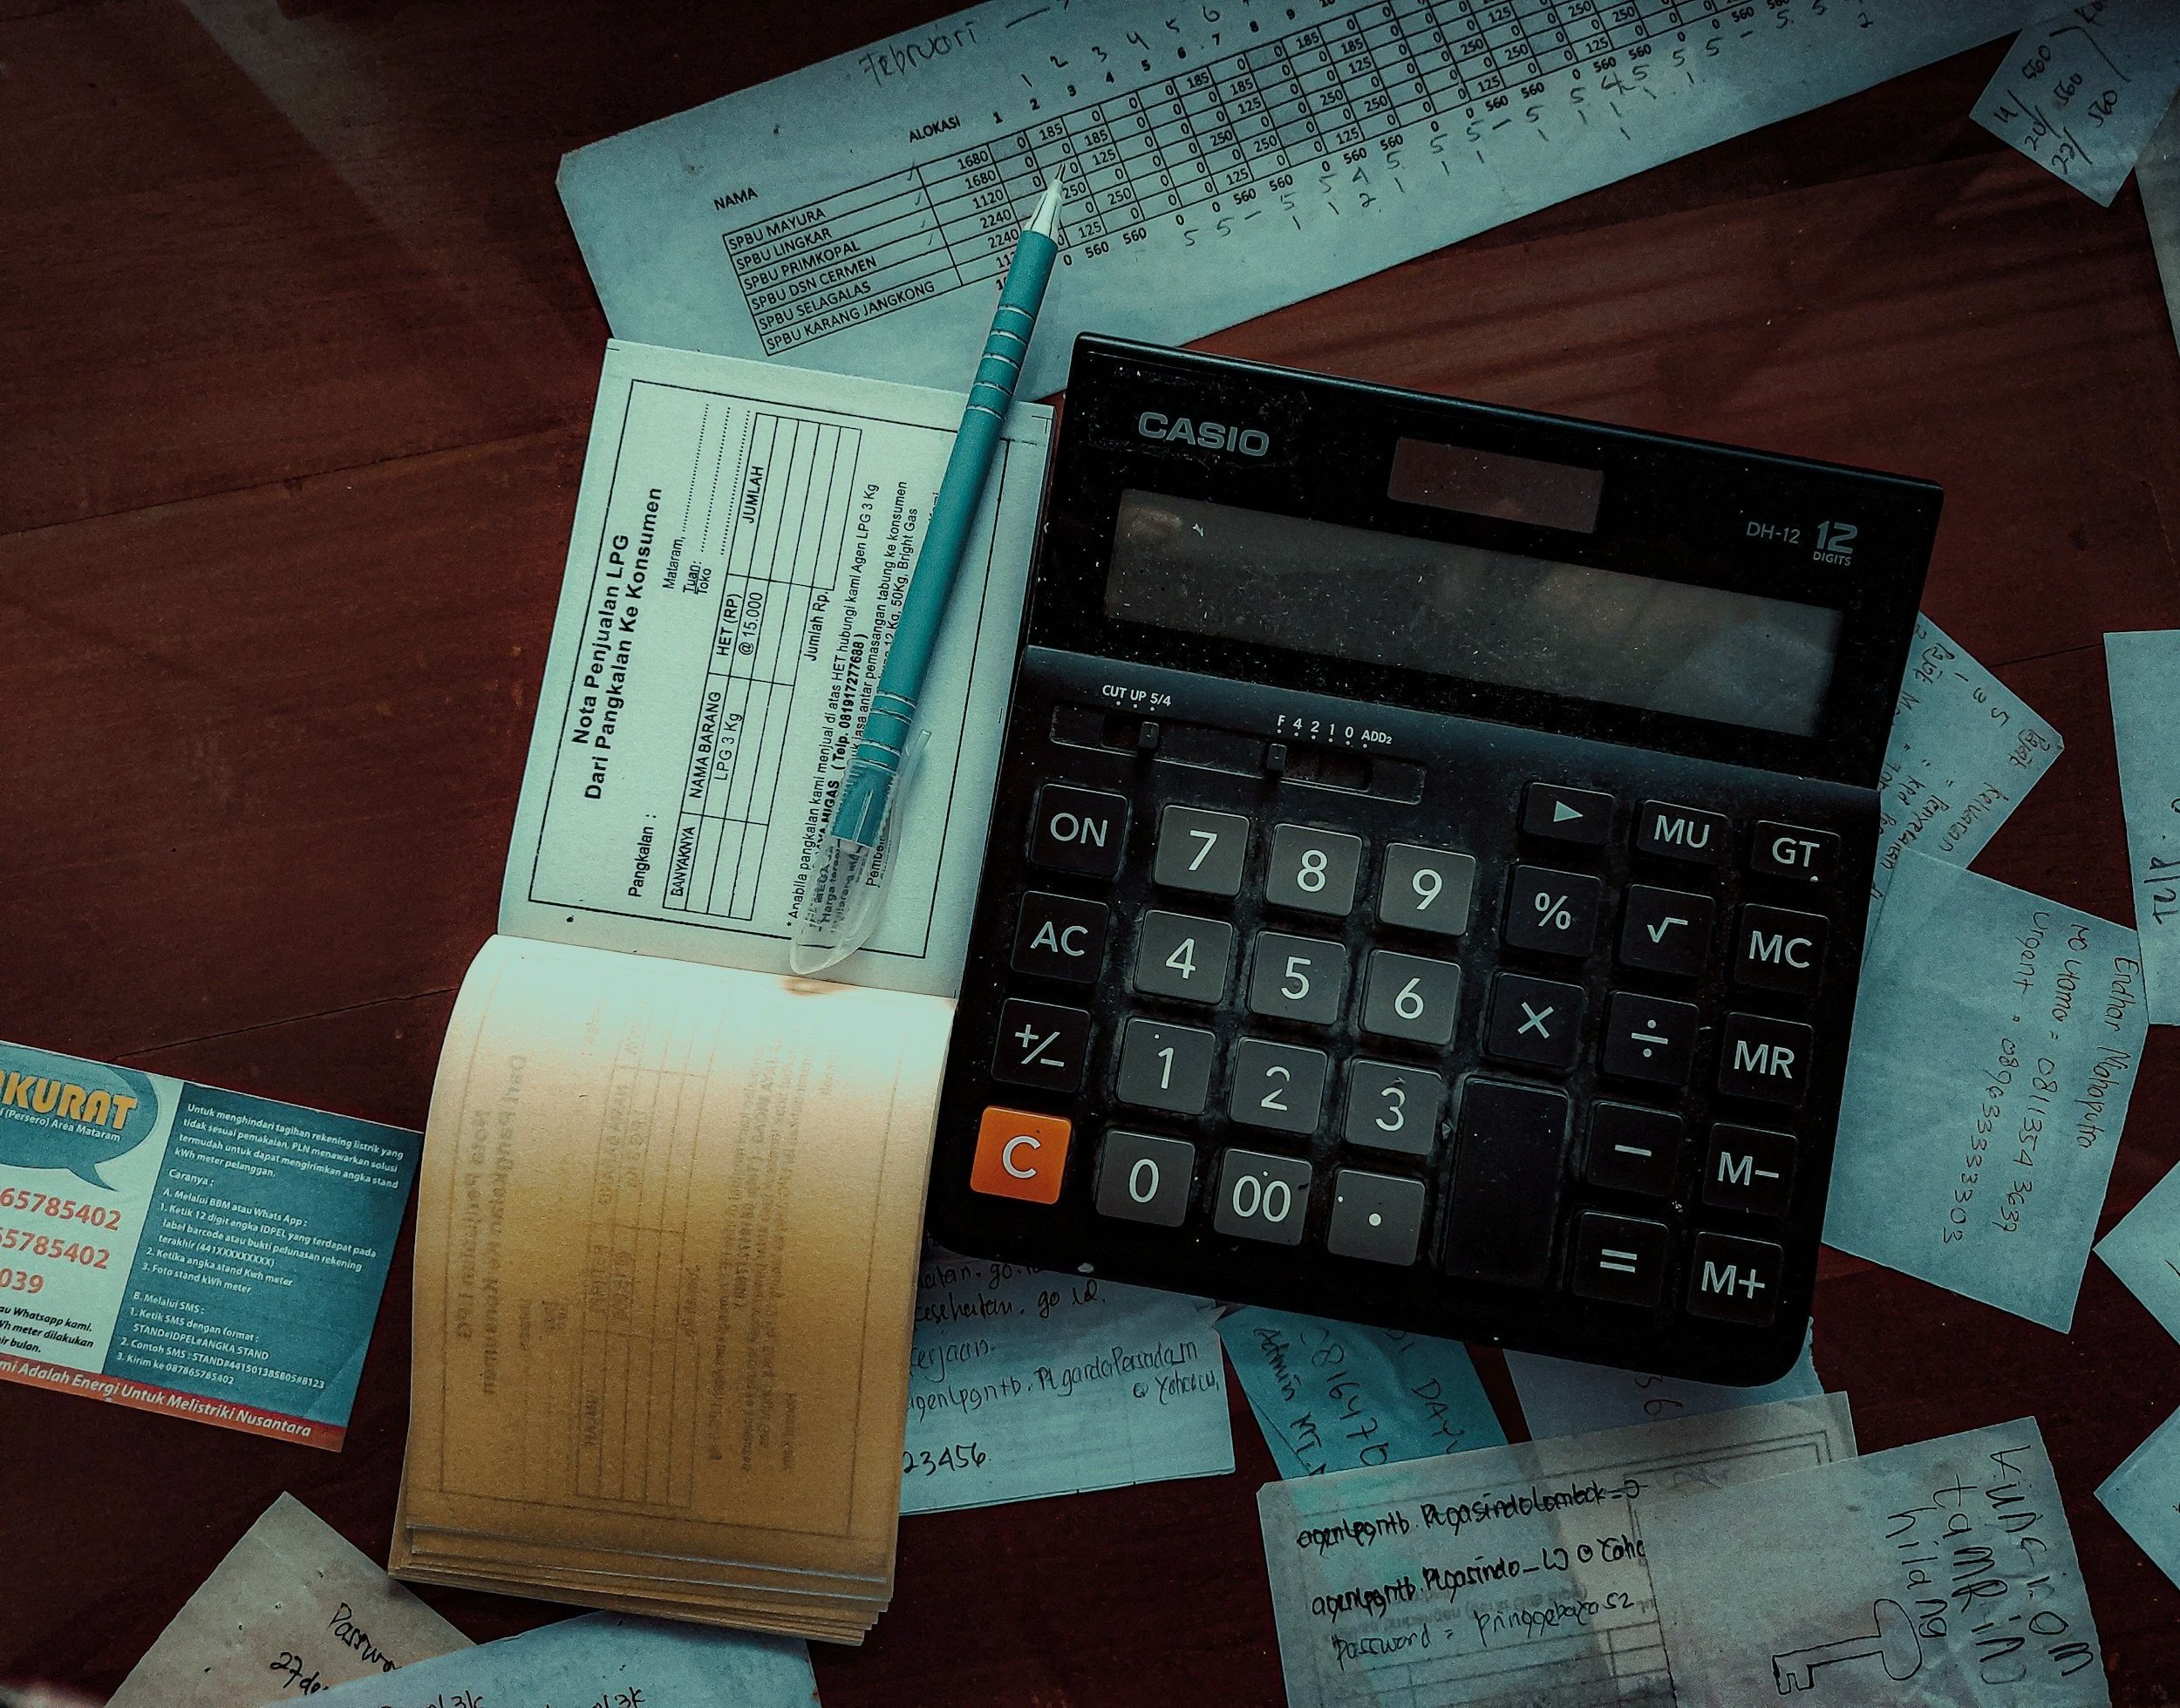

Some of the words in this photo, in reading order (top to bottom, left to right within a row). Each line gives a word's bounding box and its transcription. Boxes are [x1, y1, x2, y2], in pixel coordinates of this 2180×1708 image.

[713, 187, 759, 211] NAMA
[909, 115, 961, 143] ALOKASI
[957, 150, 989, 170] 1680
[1039, 123, 1063, 140] 185
[964, 170, 996, 189] 1680
[972, 189, 1004, 209] 1120
[728, 228, 764, 250] SPBU
[766, 208, 827, 237] MAYURA
[979, 208, 1012, 229] 2240
[987, 228, 1019, 248] 2240
[736, 248, 771, 270] SPBU
[773, 228, 833, 256] LINGKAR
[744, 268, 779, 290] SPBU
[780, 241, 861, 276] PRIMKOPAL
[751, 288, 787, 310] SPBU
[788, 276, 817, 296] DSN
[819, 255, 877, 285] CERMEN
[759, 308, 794, 330] SPBU
[796, 281, 871, 316] SELAGALAS
[766, 328, 801, 350] SPBU
[803, 307, 861, 337] KARANG
[862, 281, 935, 316] JANGKONG
[1138, 412, 1270, 457] CASIO
[742, 466, 764, 523] JUMLAH
[863, 484, 880, 500] Kg
[888, 481, 907, 541] konsumen
[856, 514, 871, 539] LPG
[904, 508, 917, 531] Gas
[1746, 521, 1800, 544] DH-12
[606, 534, 629, 578] LPG
[625, 488, 662, 599] Konsumen
[851, 542, 867, 573] Agen
[883, 544, 896, 558] ke
[896, 534, 914, 569] Bright
[1813, 549, 1853, 566] DIGITS
[1814, 521, 1857, 558] 12
[662, 536, 686, 589] Mataram,
[698, 568, 712, 593] Toko
[876, 561, 896, 600] tabung
[813, 591, 830, 611] Rp.
[844, 574, 861, 602] kami
[890, 574, 909, 609] 50Kg,
[618, 606, 638, 632] Ke
[723, 593, 743, 623] (RP)
[741, 591, 763, 636] 15.000
[583, 586, 620, 688] Penjualan
[716, 626, 733, 656] HET
[803, 616, 824, 661] Jumlah
[836, 605, 858, 652] hubungi
[865, 604, 886, 679] pemasangan
[738, 642, 754, 655] @
[831, 654, 846, 680] HET
[595, 640, 632, 749] Pangkalan
[828, 684, 841, 710] atas
[838, 641, 864, 728] 081917277688
[859, 681, 873, 712] antar
[1102, 684, 1127, 698] CUT
[1130, 689, 1147, 701] UP
[1149, 692, 1171, 707] 5/4
[571, 696, 597, 744] Nota
[698, 691, 721, 752] BARANG
[724, 712, 743, 732] Kg
[824, 711, 836, 723] di
[1277, 714, 1285, 726] F
[1292, 718, 1302, 730] 4
[1310, 720, 1319, 732] 2
[1330, 724, 1335, 735] 1
[1345, 726, 1353, 738] 0
[713, 749, 732, 780] LPG
[817, 725, 834, 772] menjual
[832, 732, 850, 761] Telp.
[584, 756, 609, 799] Dari
[689, 756, 710, 798] NAMA
[808, 776, 825, 804] kami
[800, 808, 819, 870] pangkalan
[1050, 813, 1108, 847] ON
[1189, 829, 1217, 870] 7
[1653, 814, 1710, 848] MU
[628, 826, 654, 897] Pangkalan
[671, 827, 696, 896] BANYAKNYA
[1297, 849, 1327, 892] 8
[1772, 837, 1820, 868] GT
[1413, 868, 1442, 909] 9
[1535, 892, 1570, 929] %
[1030, 921, 1088, 956] AC
[1748, 930, 1812, 968] MC
[1165, 938, 1196, 979] 4
[1281, 956, 1311, 999] 5
[1394, 977, 1423, 1019] 6
[1158, 1047, 1174, 1089] 1
[1734, 1039, 1795, 1079] MR
[1263, 1066, 1290, 1111] 2
[4, 1109, 50, 1127] (Persero)
[51, 1119, 74, 1132] Area
[76, 1124, 120, 1142] Mataram
[1375, 1087, 1406, 1131] 3
[187, 1104, 215, 1117] Untuk
[216, 1112, 275, 1130] menghindari
[276, 1124, 310, 1139] tagihan
[311, 1133, 352, 1150] rekening
[380, 1148, 404, 1160] yang
[179, 1133, 223, 1150] termudah
[225, 1145, 252, 1156] untuk
[253, 1150, 280, 1163] dapat
[280, 1157, 341, 1176] mengirimkan
[343, 1171, 371, 1182] angka
[372, 1178, 399, 1188] stand
[291, 1142, 310, 1153] PLN
[371, 1161, 398, 1173] solusi
[1002, 1135, 1041, 1178] C
[168, 1169, 208, 1186] Caranya
[1129, 1159, 1159, 1202] 0
[1232, 1175, 1291, 1222] 00
[1701, 1261, 1765, 1299] M+
[11, 1325, 44, 1336] meter
[44, 1330, 93, 1348] dilakukan
[13, 1307, 64, 1327] Whatsapp
[64, 1318, 92, 1332] kami.
[10, 1337, 41, 1352] bulan.
[18, 1362, 72, 1385] Adalah
[72, 1374, 121, 1396] Energi
[121, 1384, 166, 1405] Untuk
[166, 1394, 235, 1419] Melistriki
[235, 1409, 311, 1437] Nusantara
